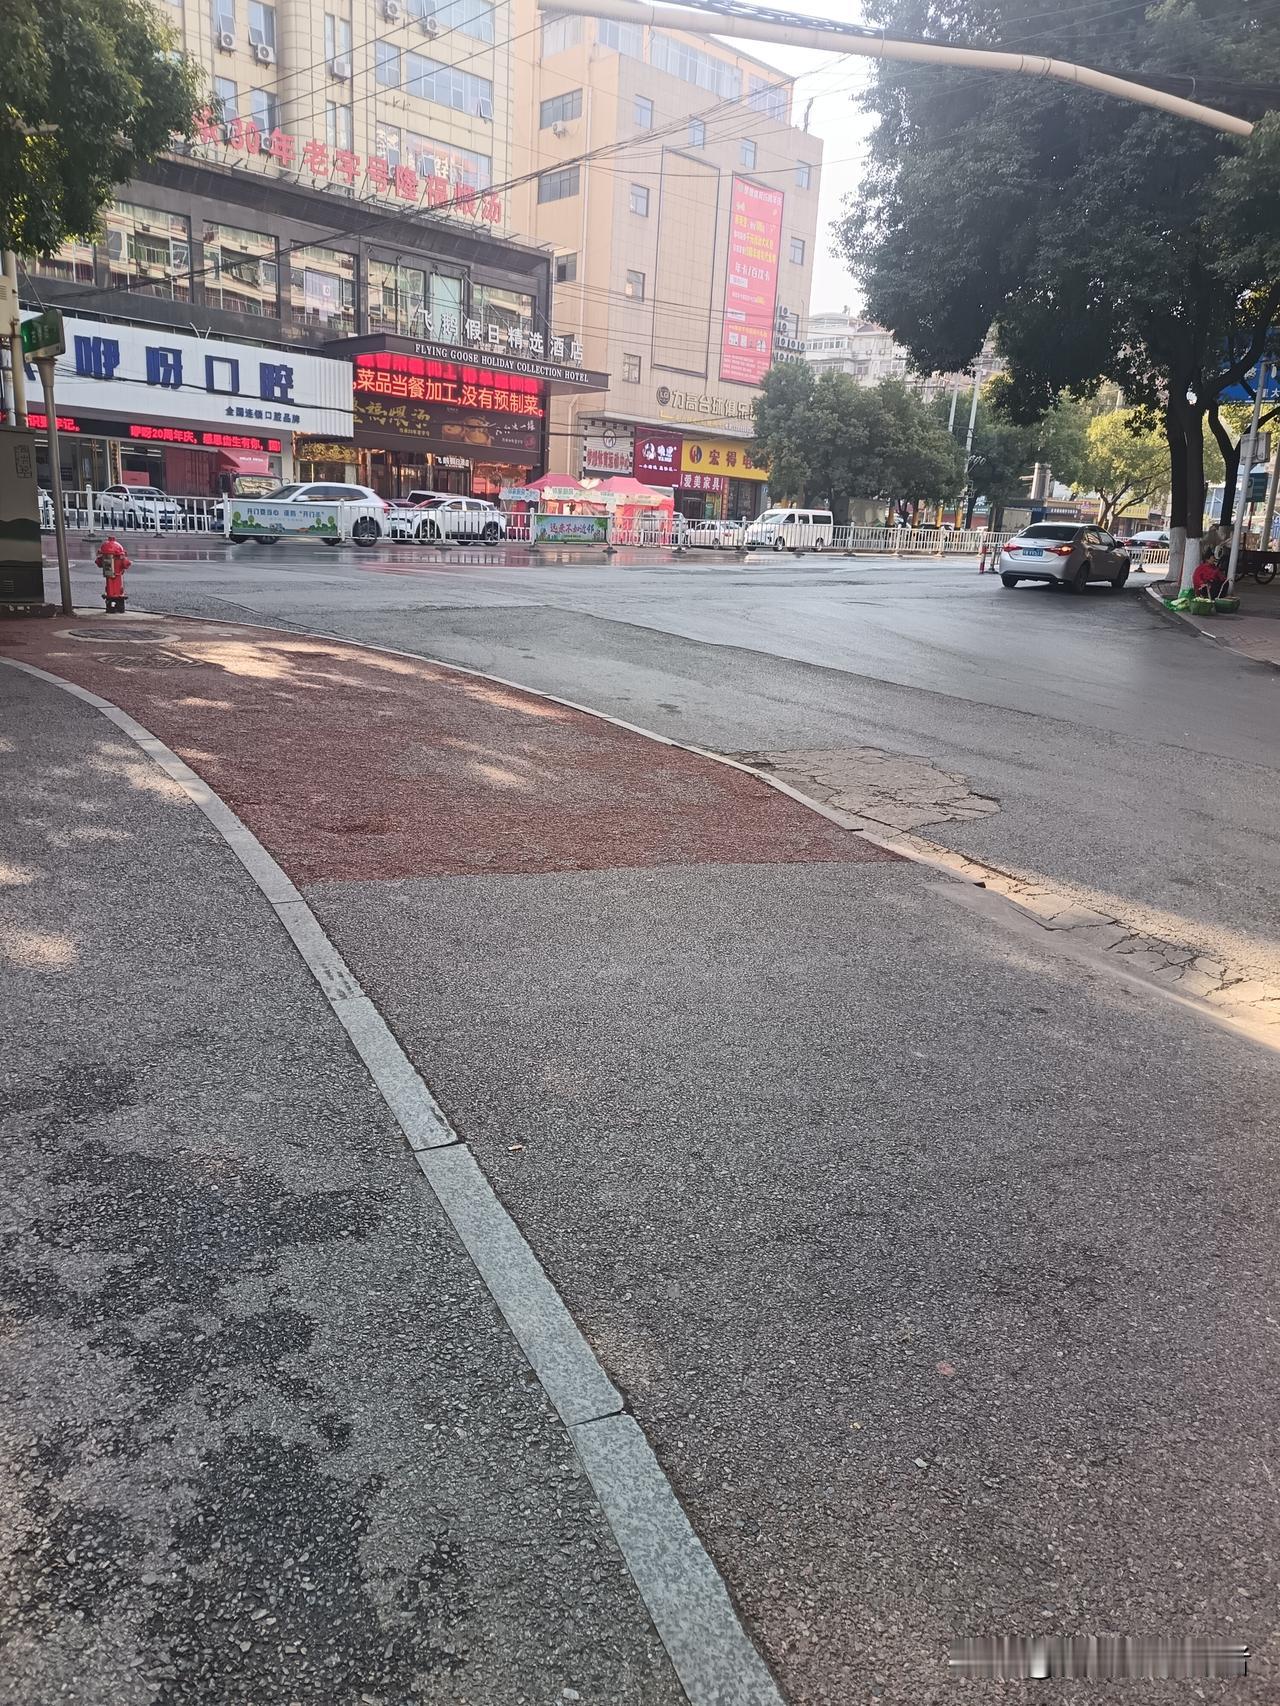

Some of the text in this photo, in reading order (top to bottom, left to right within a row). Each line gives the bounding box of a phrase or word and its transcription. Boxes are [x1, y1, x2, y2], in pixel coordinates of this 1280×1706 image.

[416, 309, 584, 361] 飞鹅假日精选酒店
[415, 343, 589, 383] FLYING GOOSE HOLIDAY COLLECTION HOTEL
[225, 406, 300, 424] 全国连锁口腔品牌
[684, 474, 721, 491] 爱美家具
